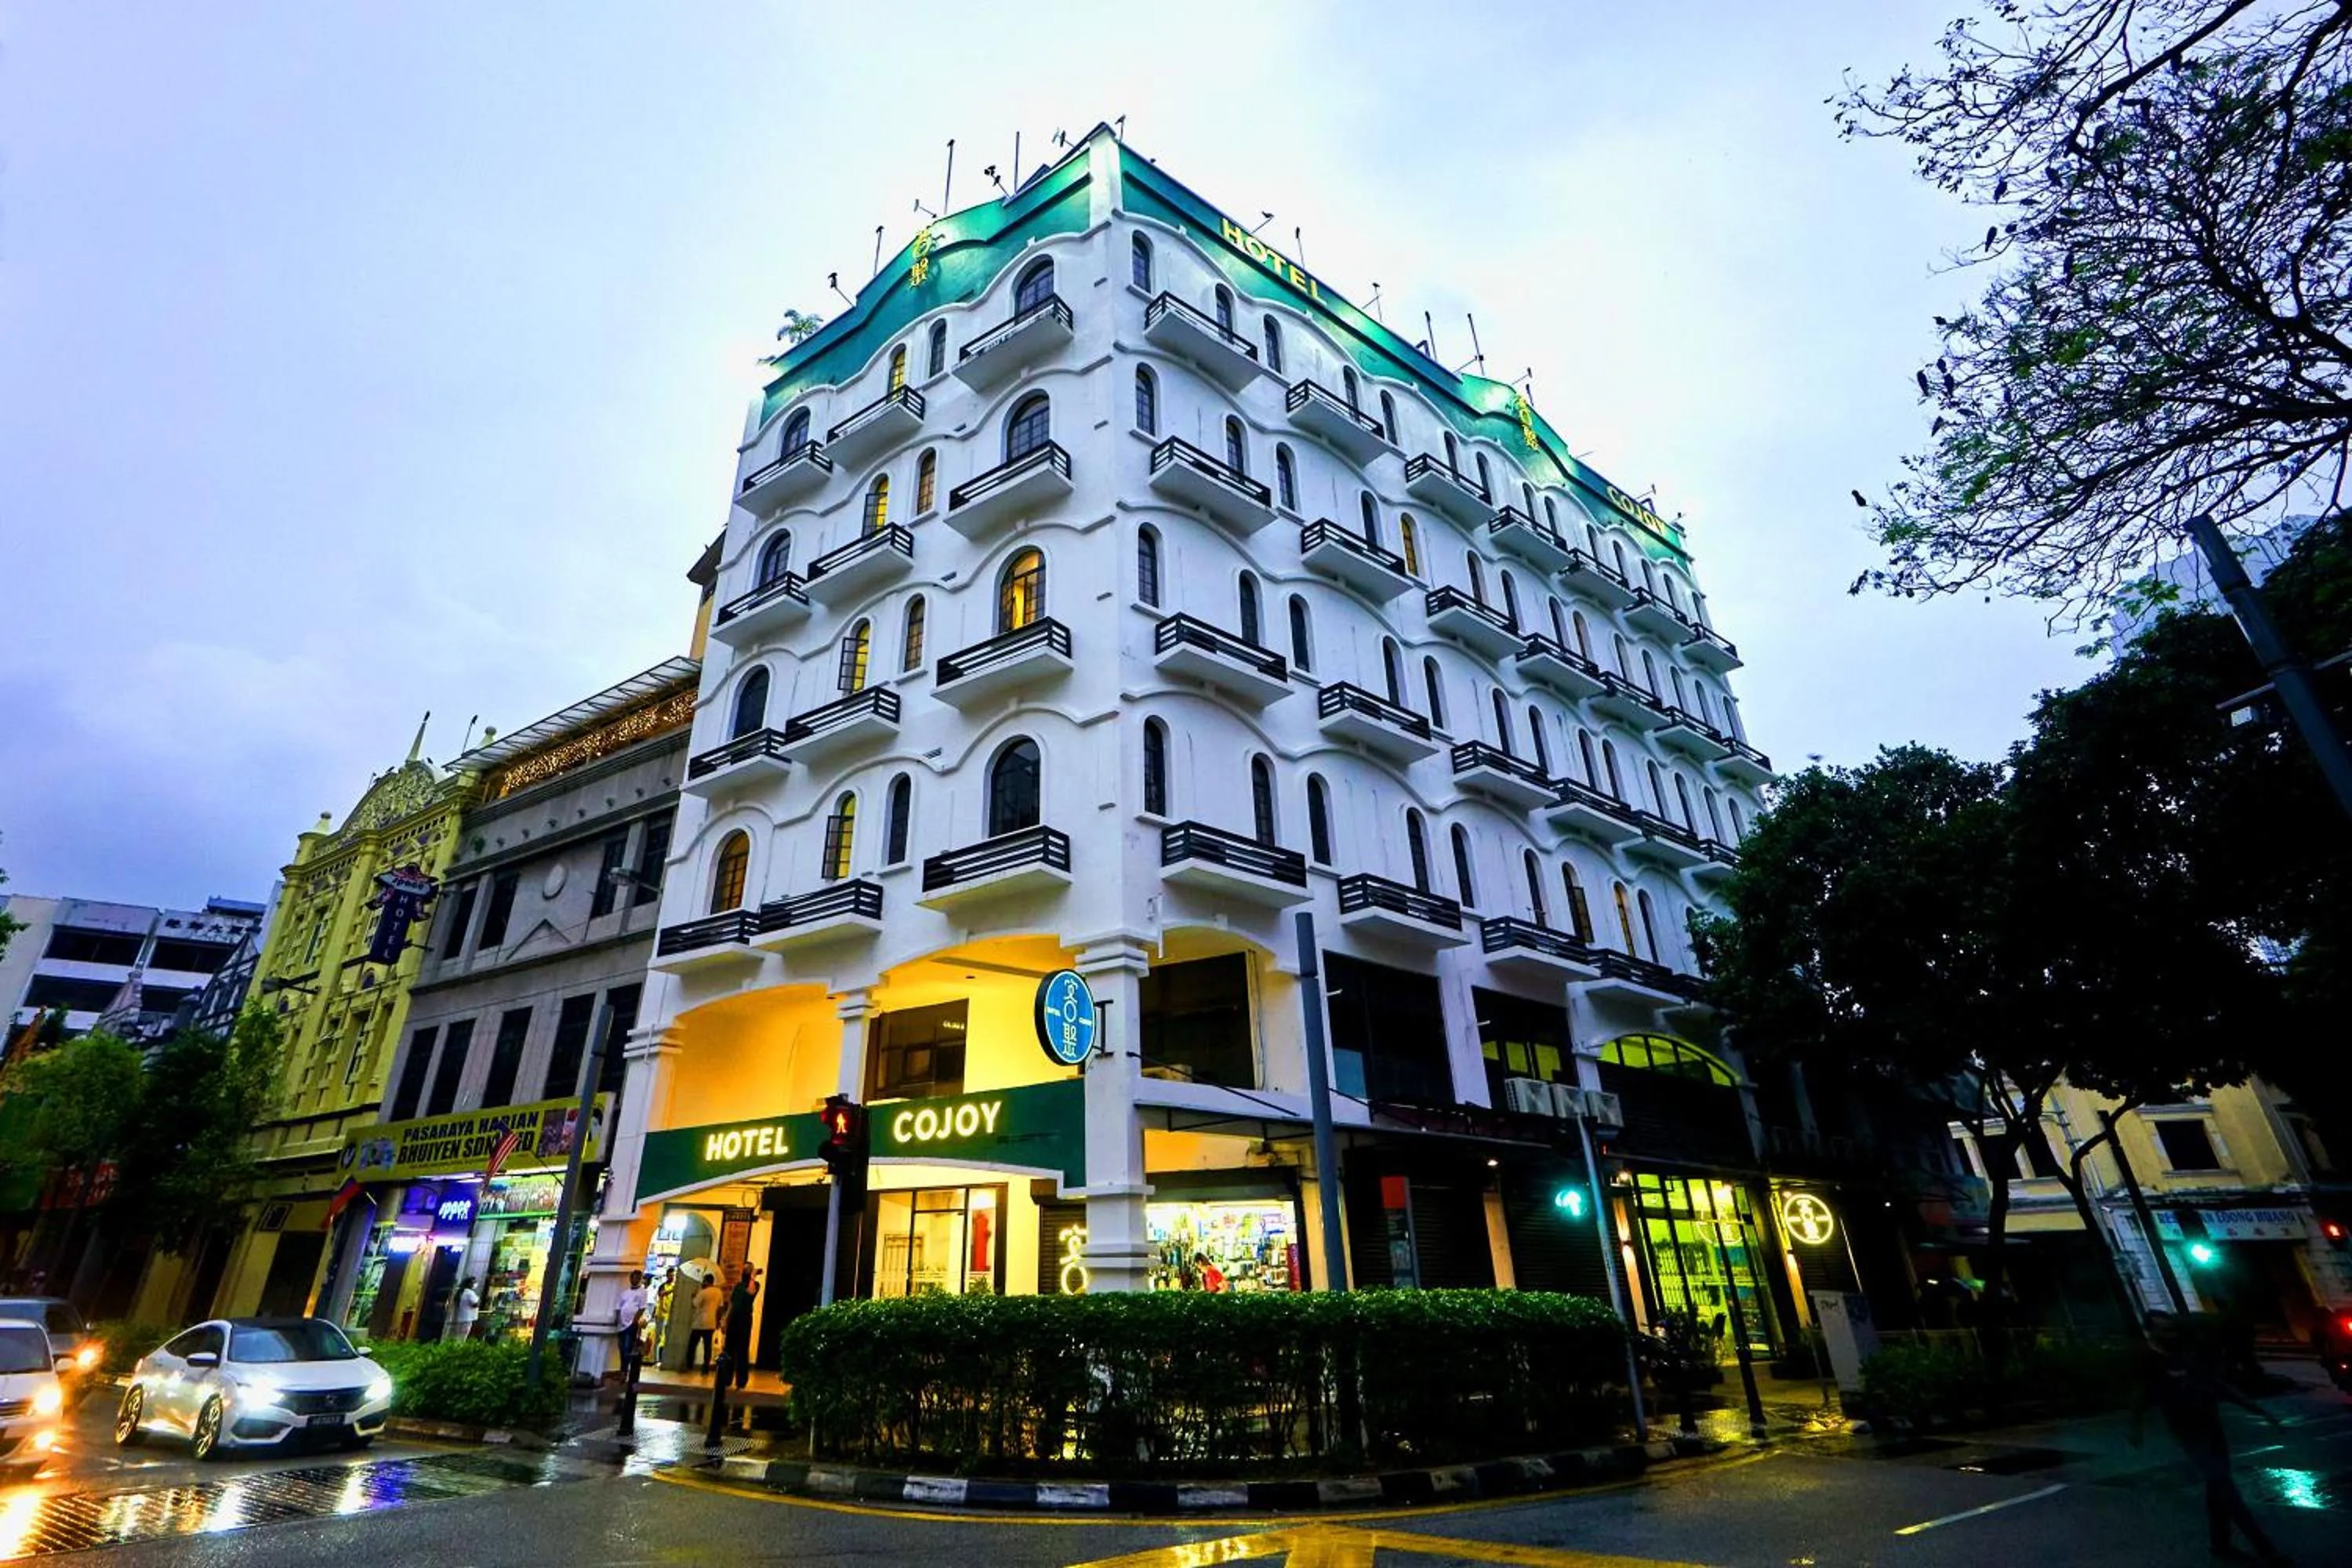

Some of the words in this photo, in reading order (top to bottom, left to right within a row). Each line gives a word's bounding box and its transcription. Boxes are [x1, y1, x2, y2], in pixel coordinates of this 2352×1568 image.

[1221, 218, 1327, 307] HOTEL
[1606, 485, 1664, 535] COJOY
[383, 895, 408, 958] HOTEL
[397, 1137, 461, 1164] BHUIYEN
[403, 1119, 474, 1143] PASARAYA
[706, 1126, 789, 1161] HOTEL
[892, 1101, 1002, 1142] COJOY
